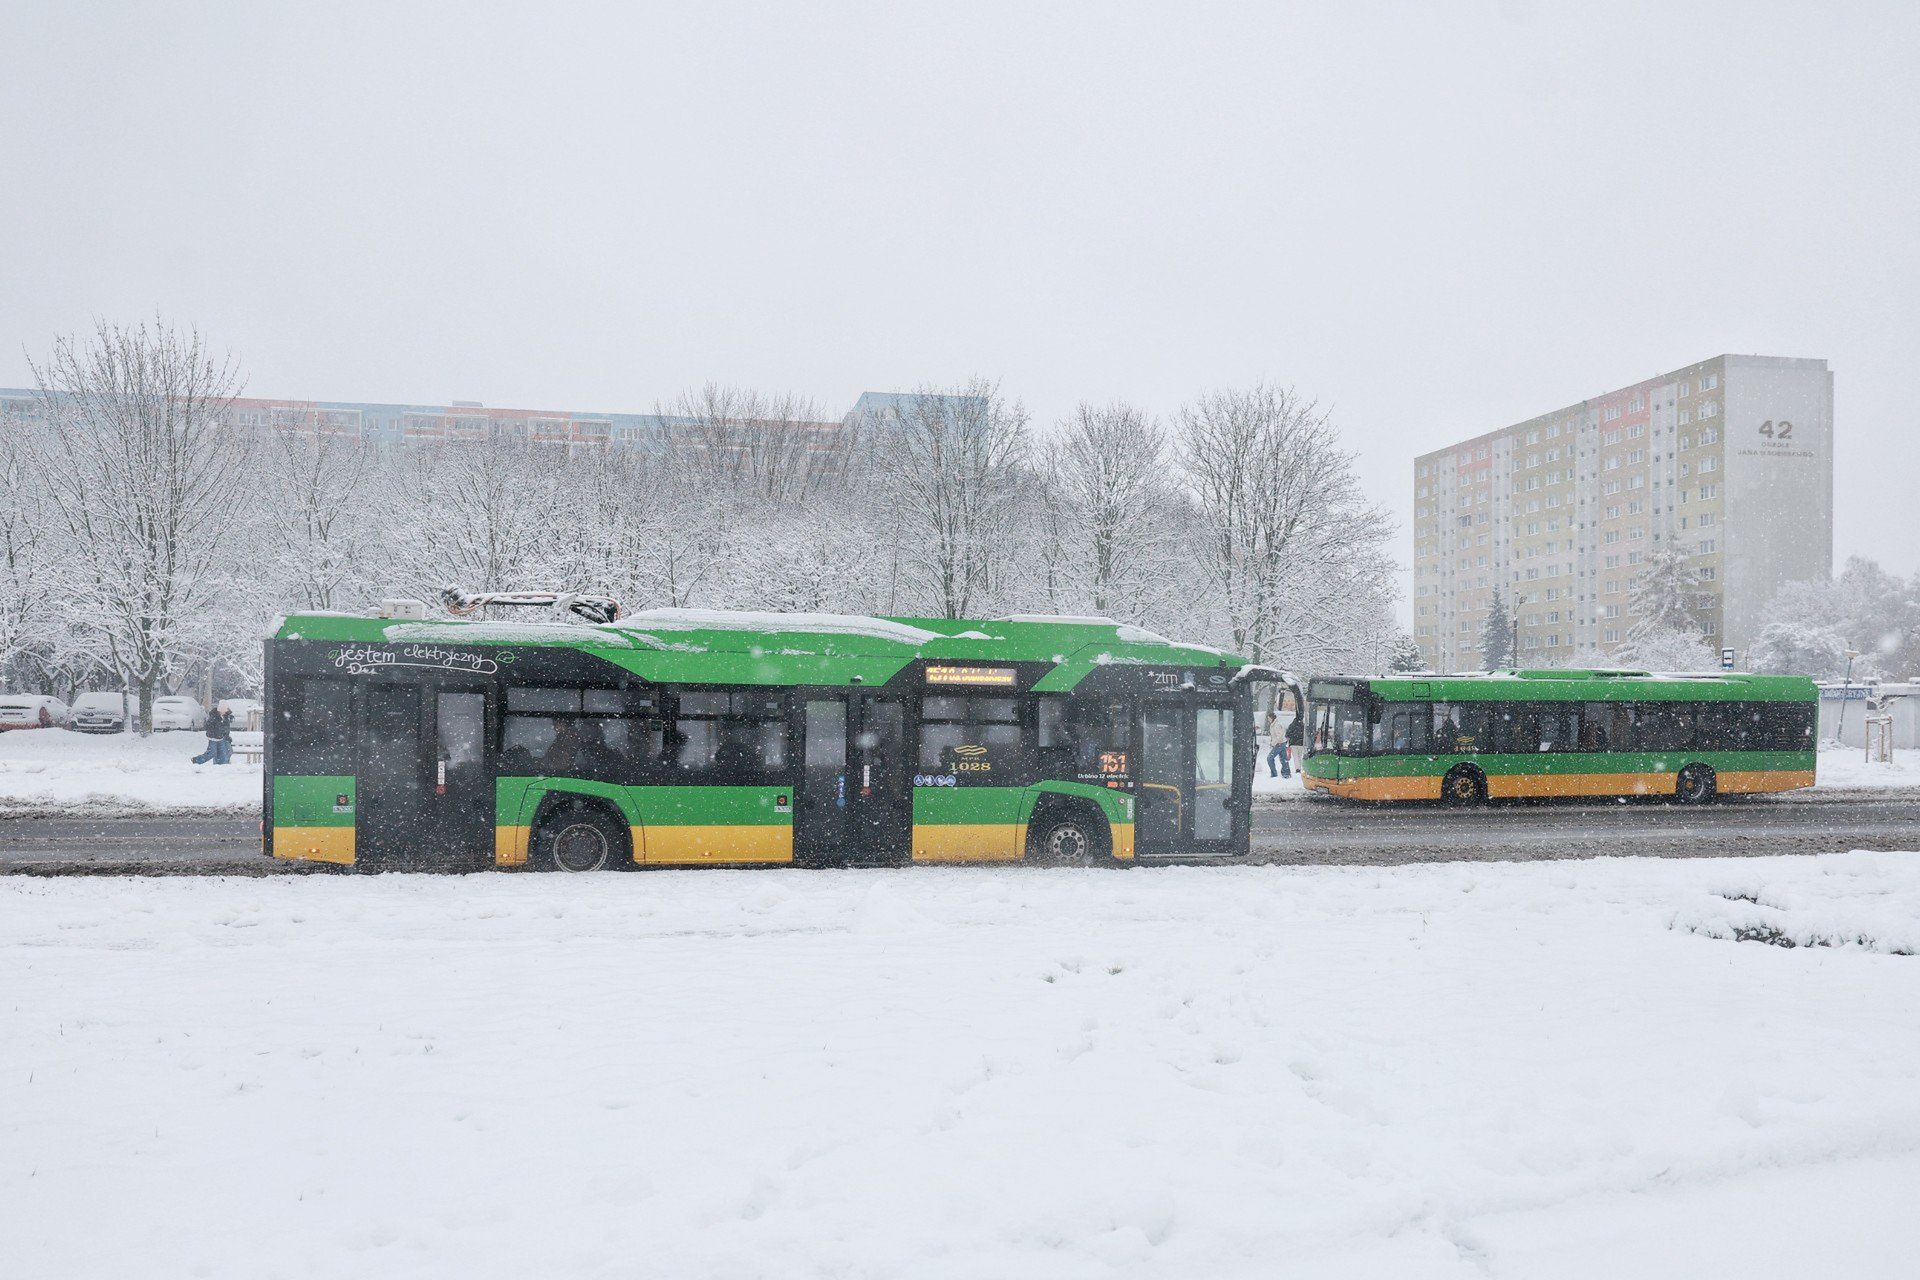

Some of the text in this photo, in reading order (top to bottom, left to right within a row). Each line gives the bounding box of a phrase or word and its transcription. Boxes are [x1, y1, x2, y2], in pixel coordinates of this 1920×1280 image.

[1758, 420, 1793, 439] 42
[334, 644, 485, 669] jestem elektryczny
[1154, 671, 1178, 684] ztm
[949, 762, 991, 771] 1028
